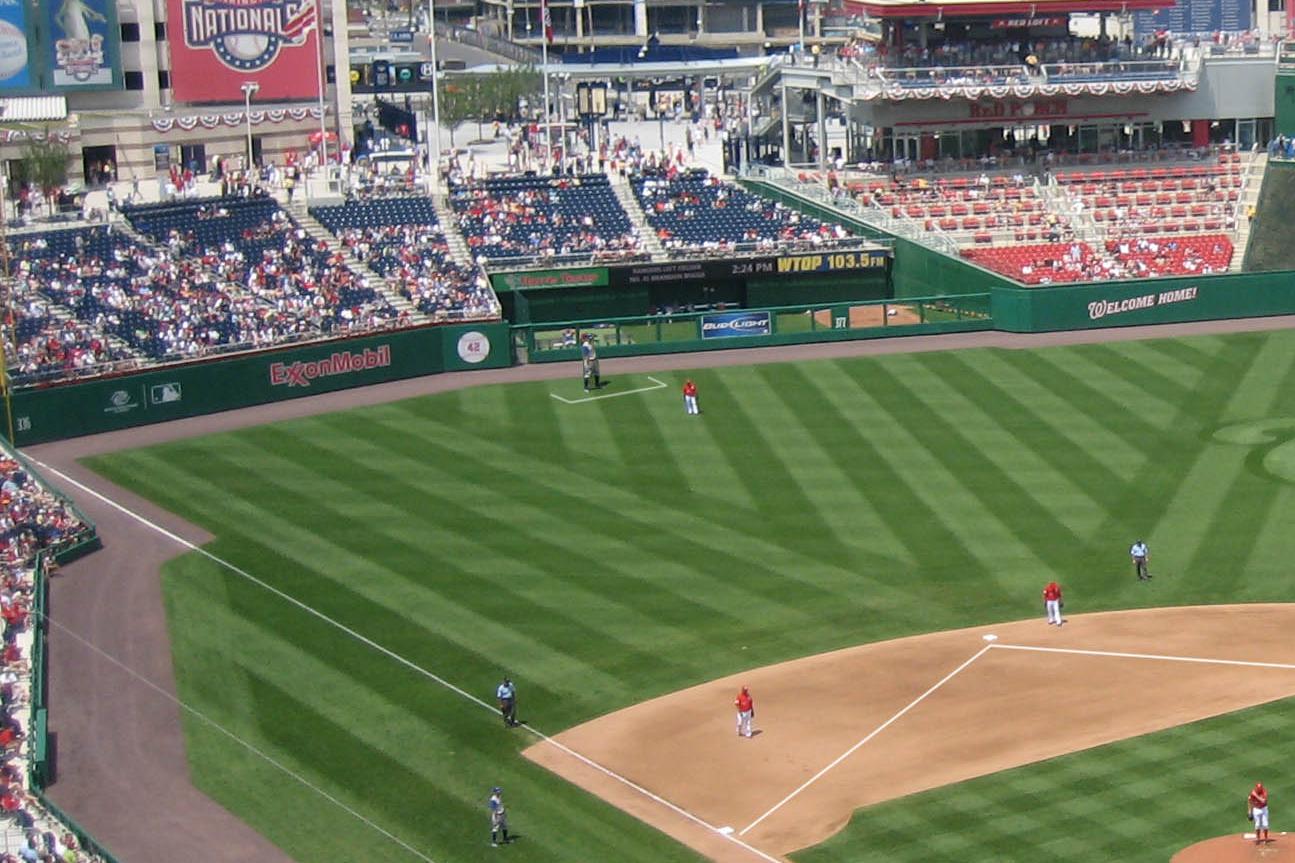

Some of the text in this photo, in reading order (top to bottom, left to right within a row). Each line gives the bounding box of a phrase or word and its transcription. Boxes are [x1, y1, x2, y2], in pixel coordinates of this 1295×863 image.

[777, 256, 822, 273] WTOP
[1088, 287, 1198, 319] WELCOME HOME!
[467, 341, 481, 353] 42
[270, 344, 391, 387] ExxonMobil
